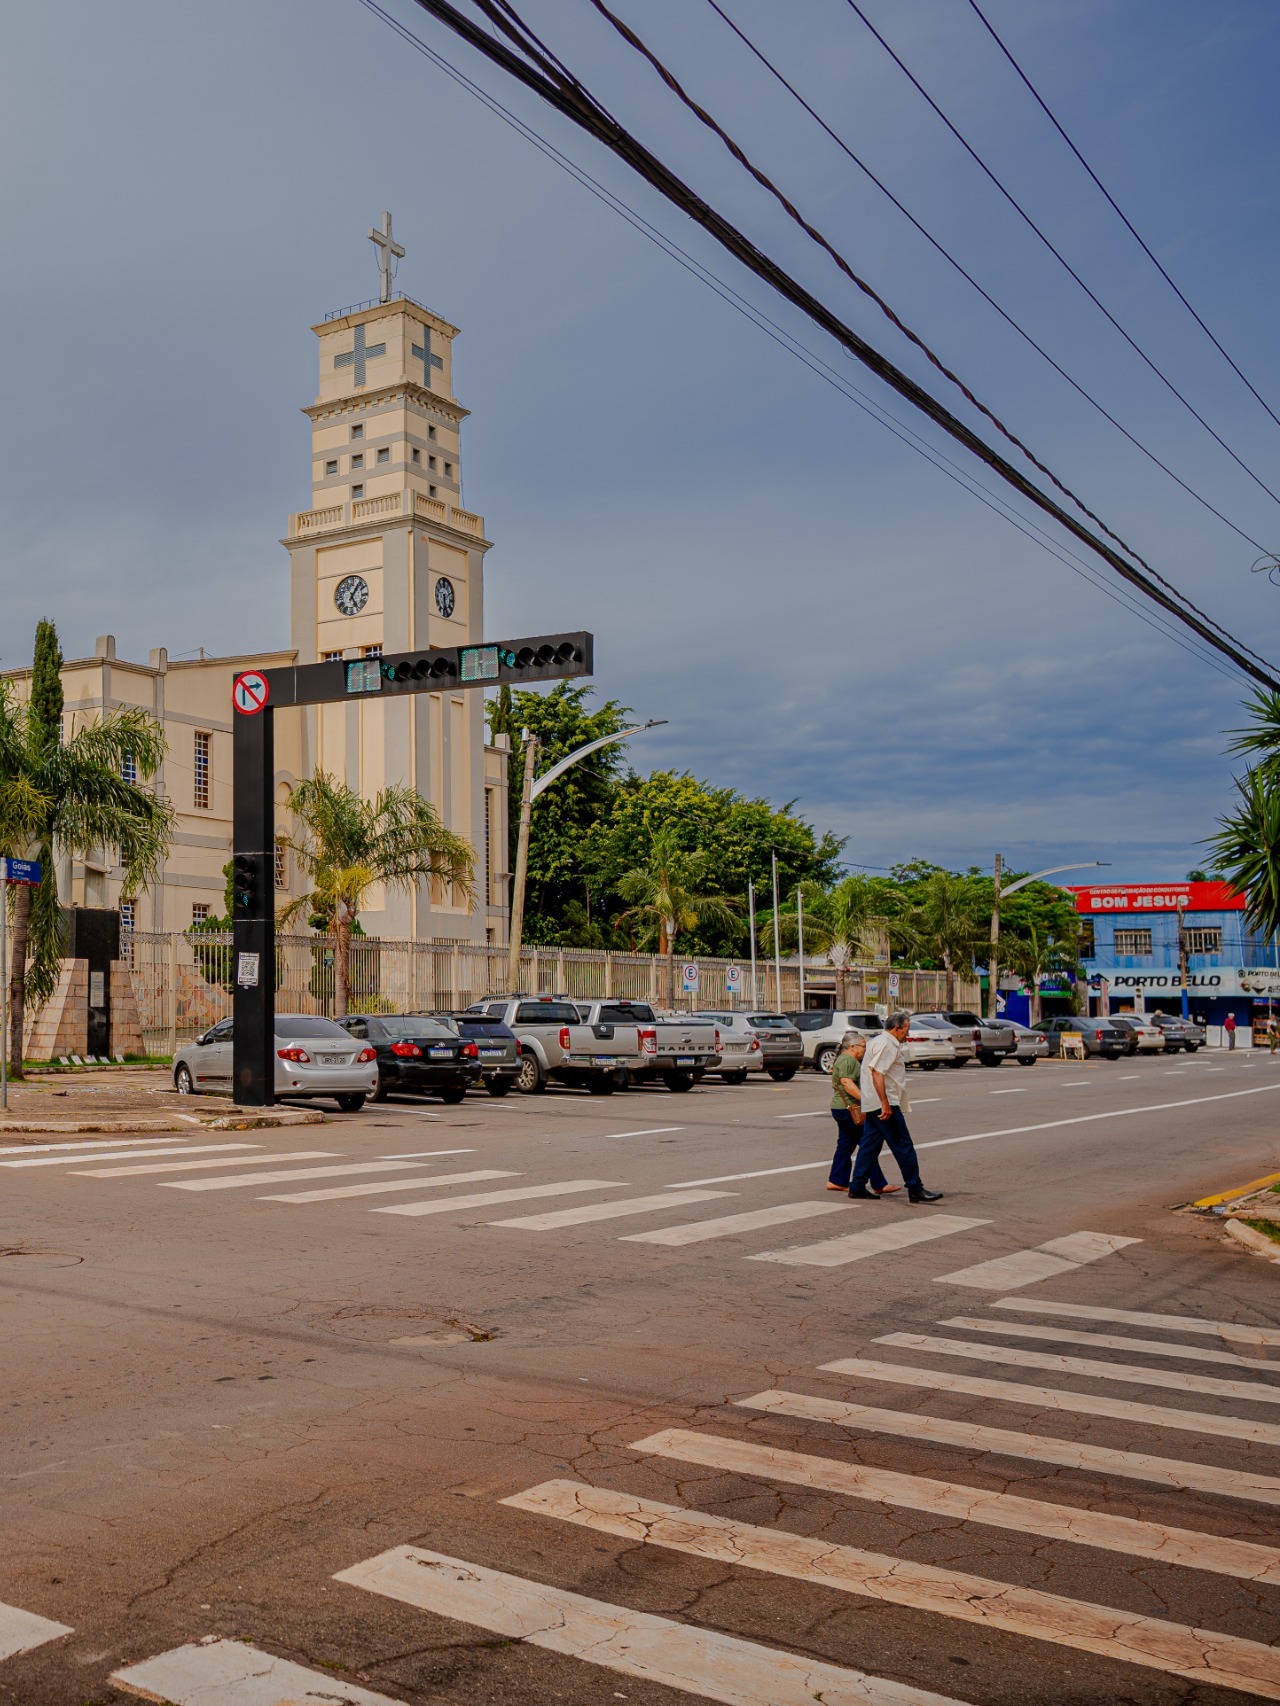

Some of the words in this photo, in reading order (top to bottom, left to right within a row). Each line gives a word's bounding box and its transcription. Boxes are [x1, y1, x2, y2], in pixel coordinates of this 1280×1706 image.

[1090, 896, 1128, 909] BOM
[1132, 894, 1190, 908] JESUS
[688, 968, 694, 978] E
[730, 969, 736, 979] E
[1114, 975, 1168, 987] PORTO
[1171, 975, 1221, 987] BELLO
